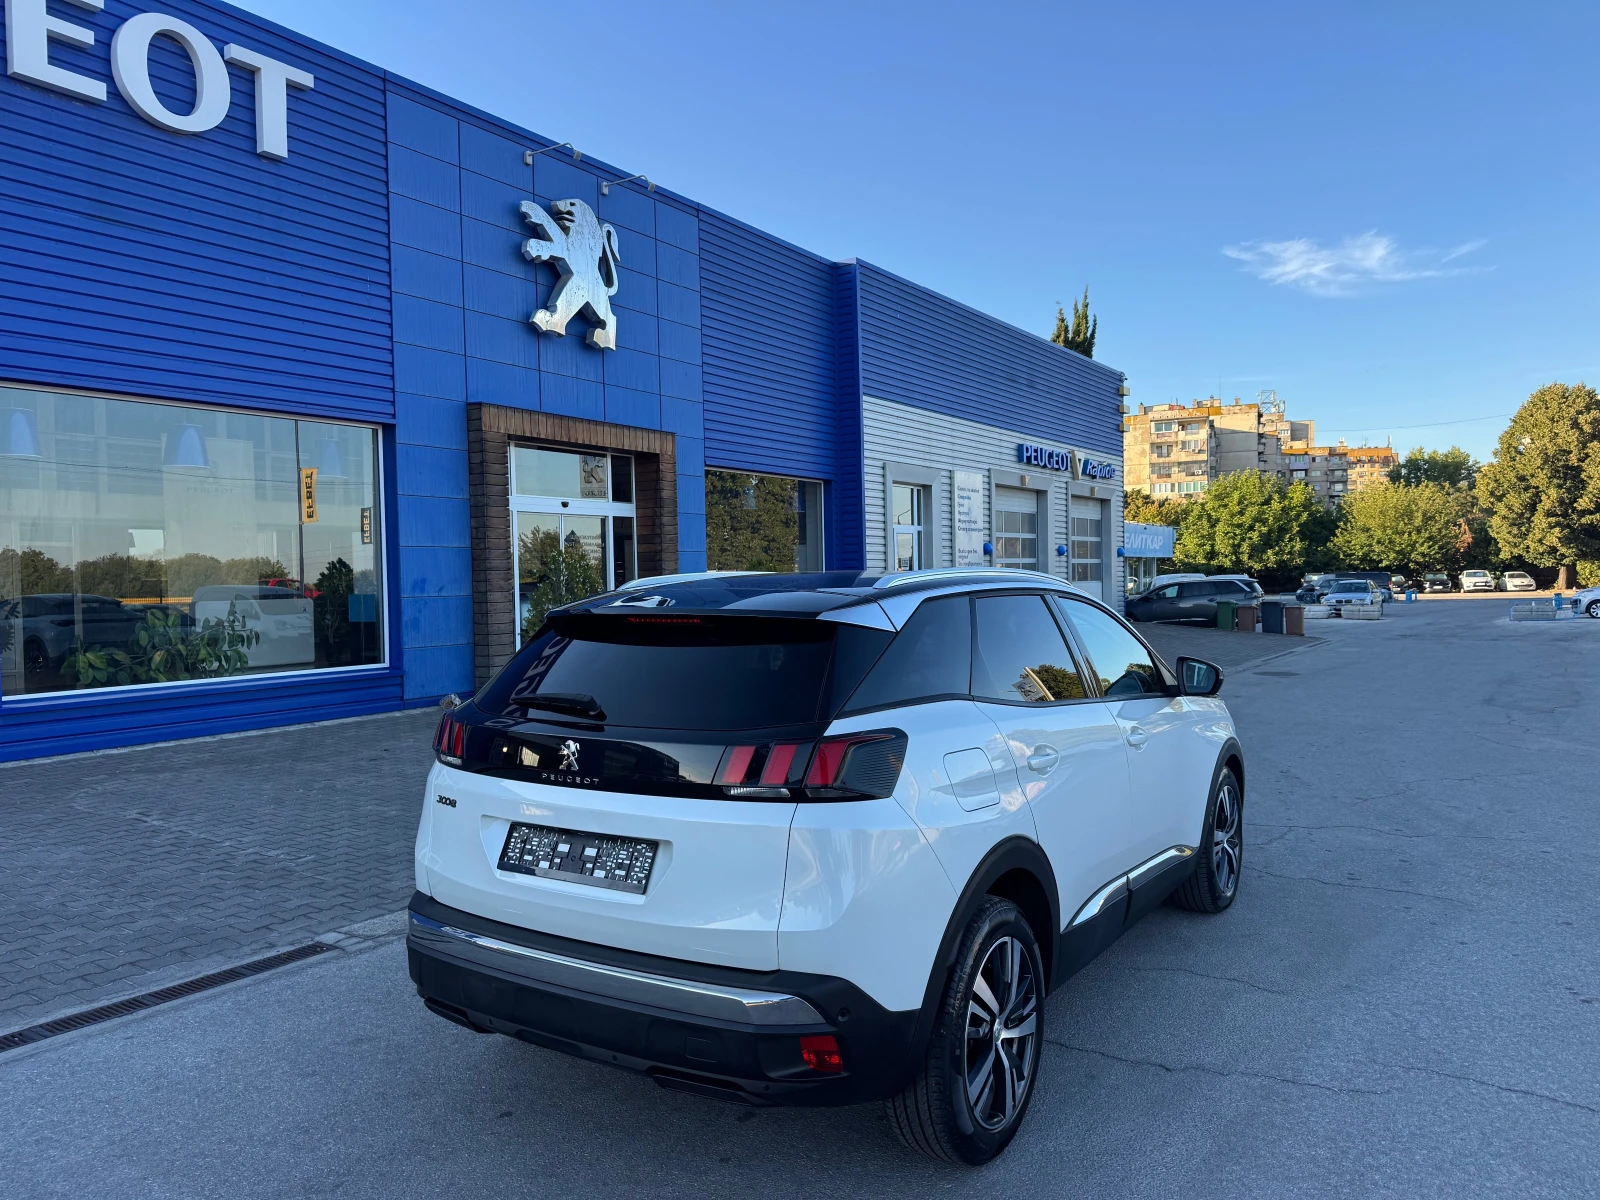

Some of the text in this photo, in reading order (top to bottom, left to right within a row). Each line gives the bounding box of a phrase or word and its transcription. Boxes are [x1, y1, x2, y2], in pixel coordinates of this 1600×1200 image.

[1021, 443, 1116, 480] PEUGEOT Rapide
[541, 772, 600, 785] PEUGEOT
[436, 794, 457, 808] 3008
